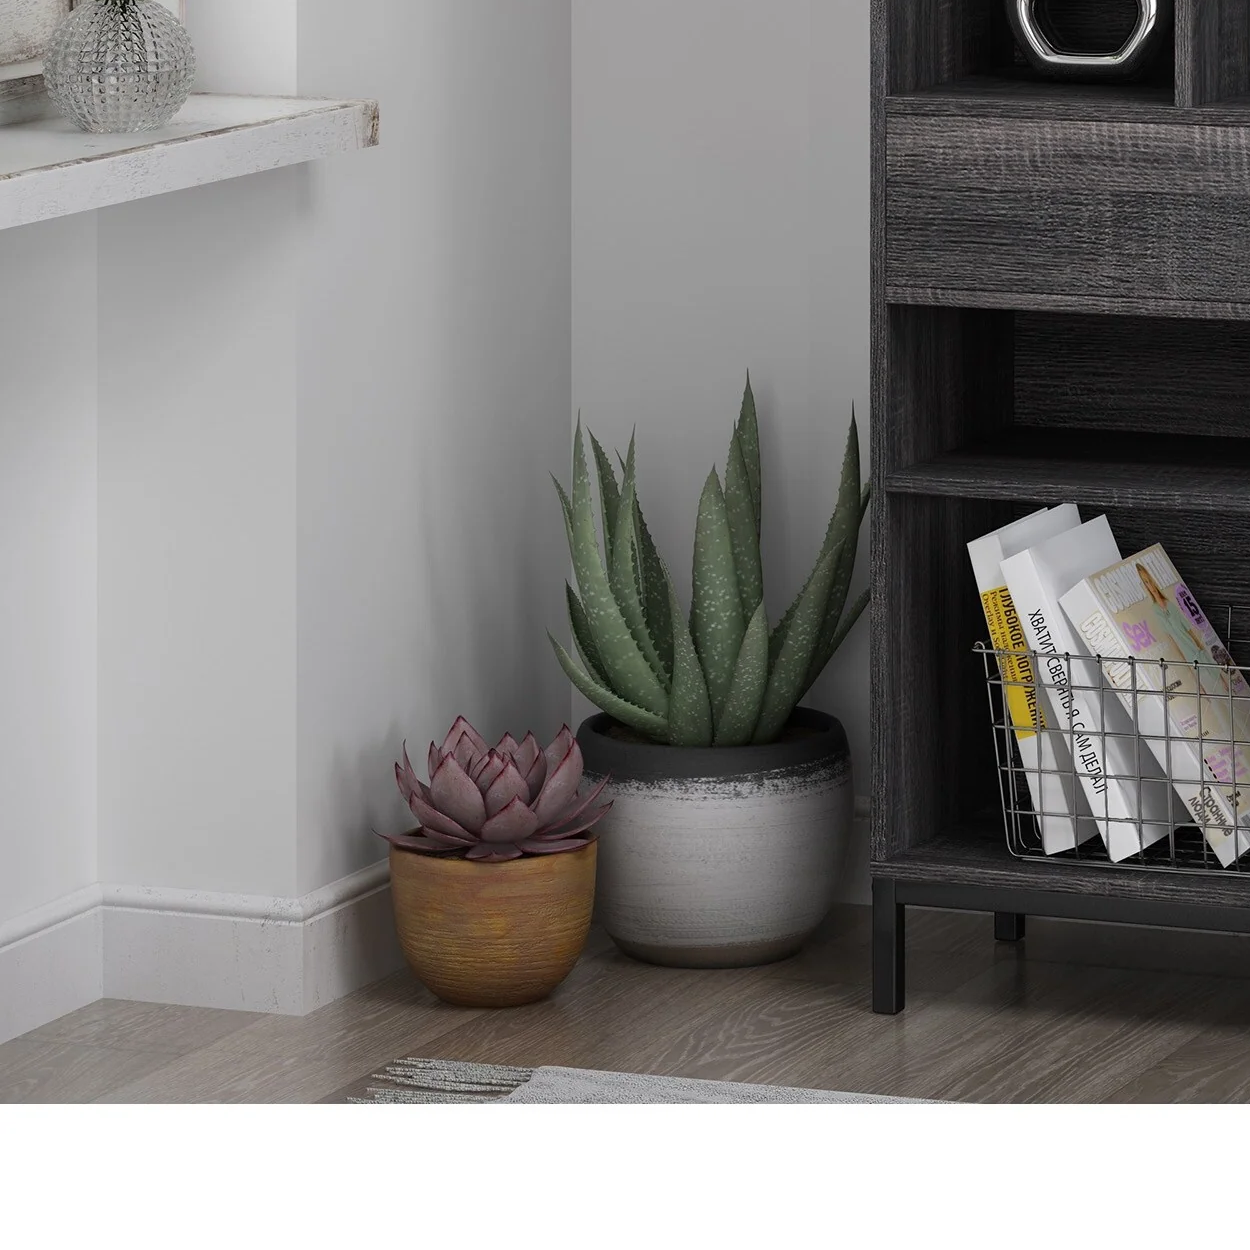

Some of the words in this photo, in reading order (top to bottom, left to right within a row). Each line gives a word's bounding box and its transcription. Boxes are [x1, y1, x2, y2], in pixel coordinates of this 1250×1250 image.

[1093, 549, 1179, 615] COSMOPITAN
[1183, 595, 1200, 618] 15
[1028, 608, 1058, 657] ХВАТИТ
[1121, 619, 1158, 653] Sex
[1072, 723, 1092, 752] САМ
[1079, 751, 1108, 794] ДЕЛАЛ
